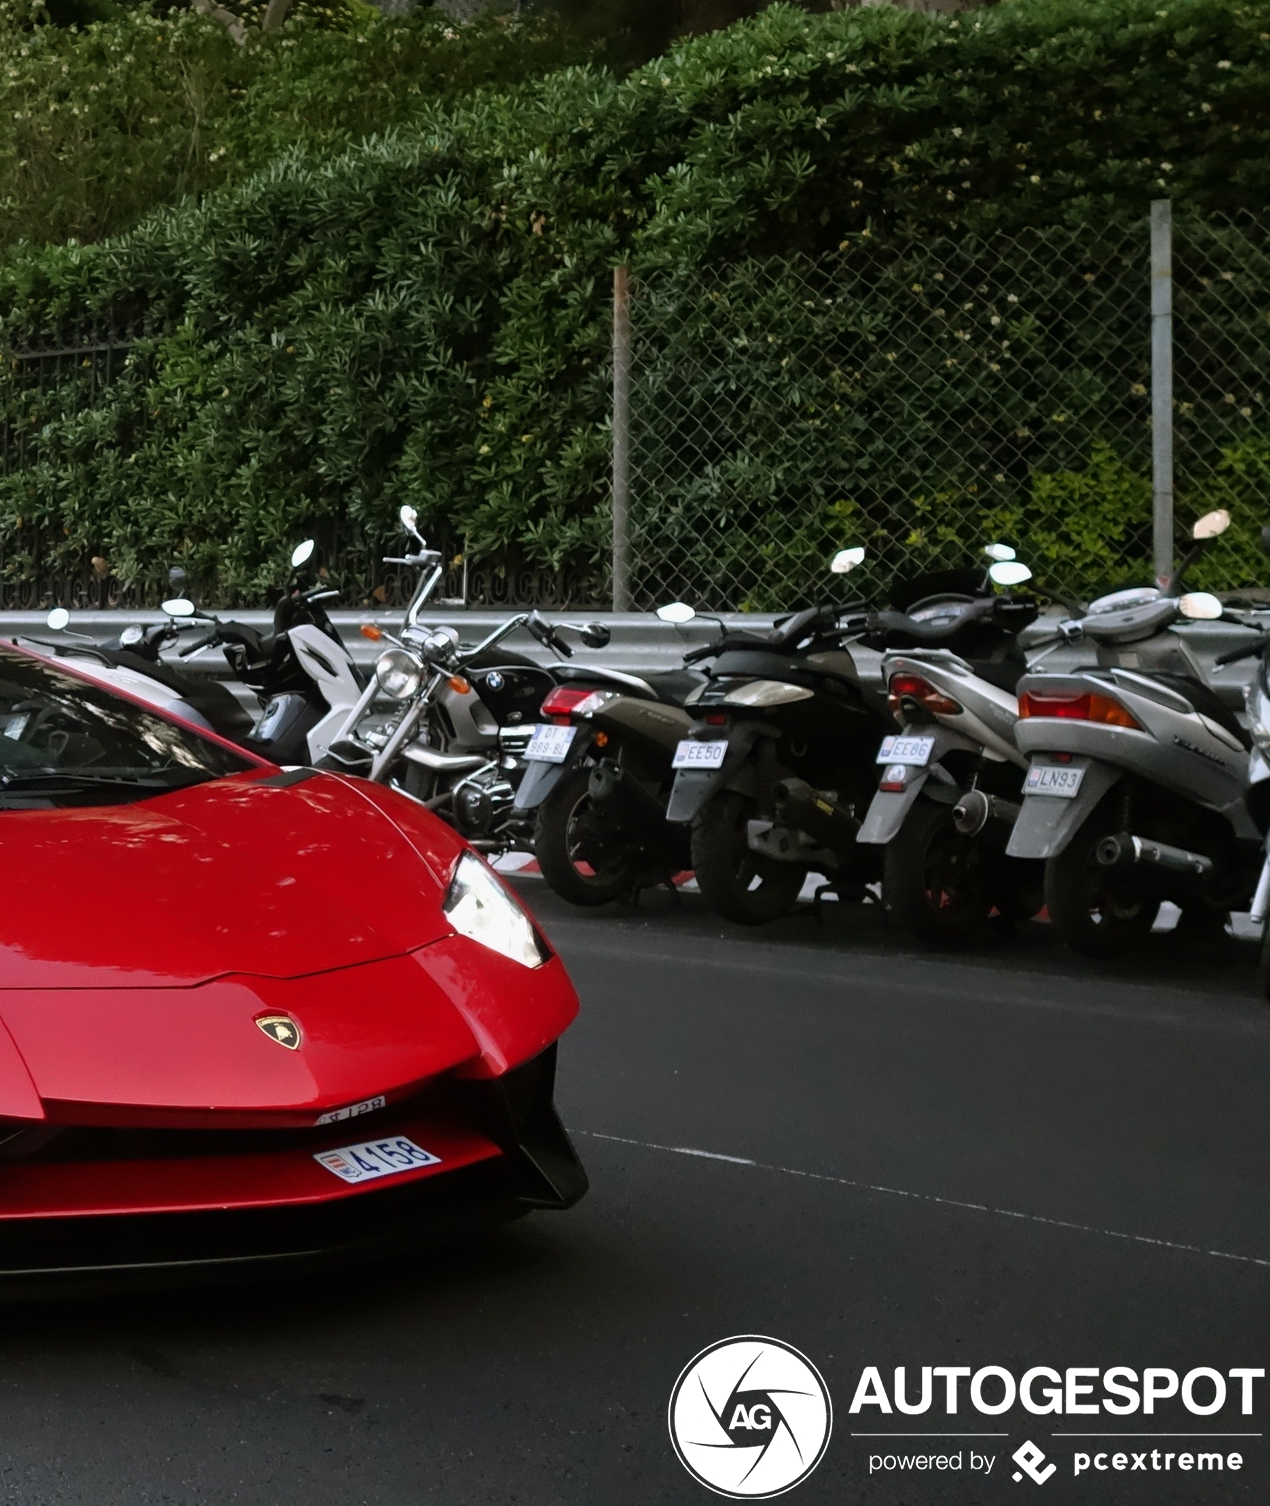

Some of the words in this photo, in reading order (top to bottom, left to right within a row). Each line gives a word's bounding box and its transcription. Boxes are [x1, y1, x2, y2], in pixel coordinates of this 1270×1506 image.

[687, 745, 722, 760] EE50
[892, 741, 929, 757] EE86
[1040, 770, 1078, 788] LN93
[349, 1140, 431, 1172] 4158
